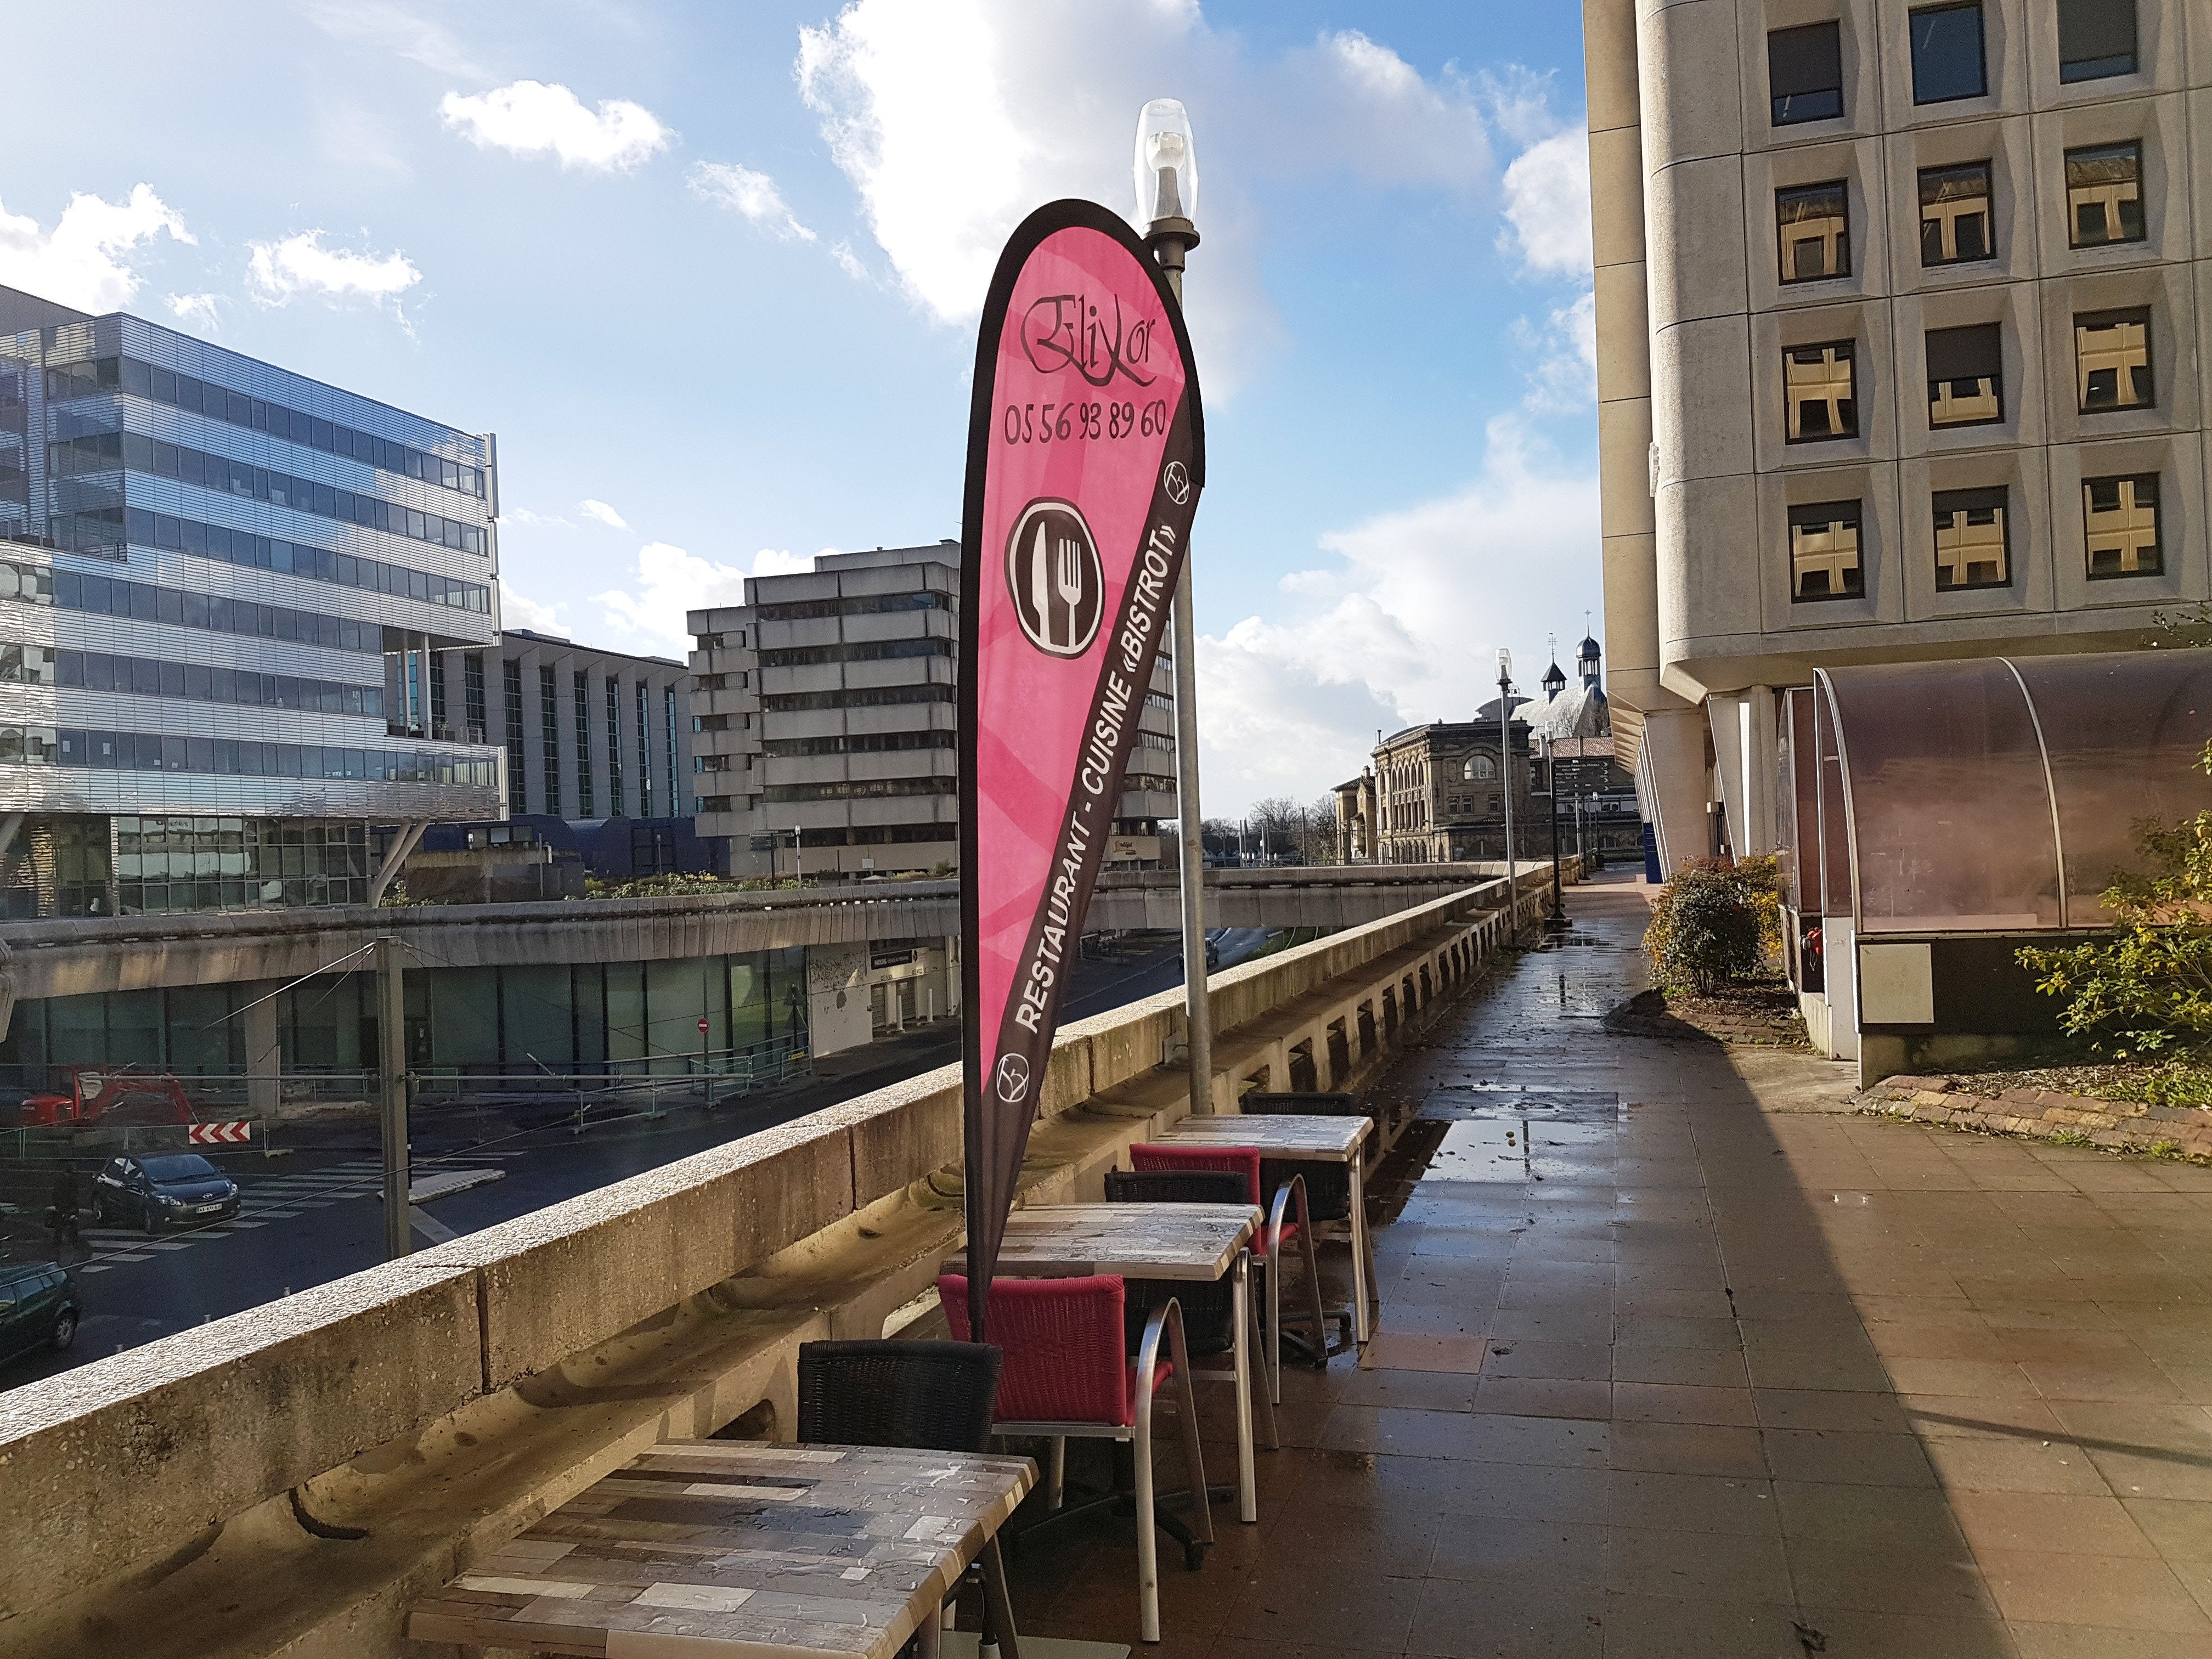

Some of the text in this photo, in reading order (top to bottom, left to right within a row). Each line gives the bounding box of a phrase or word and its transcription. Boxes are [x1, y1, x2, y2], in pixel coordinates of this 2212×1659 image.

[1005, 399, 1166, 445] 05 56 93 89 60
[1015, 810, 1091, 1034] RESTAURANT
[1082, 670, 1132, 795] CUISINE
